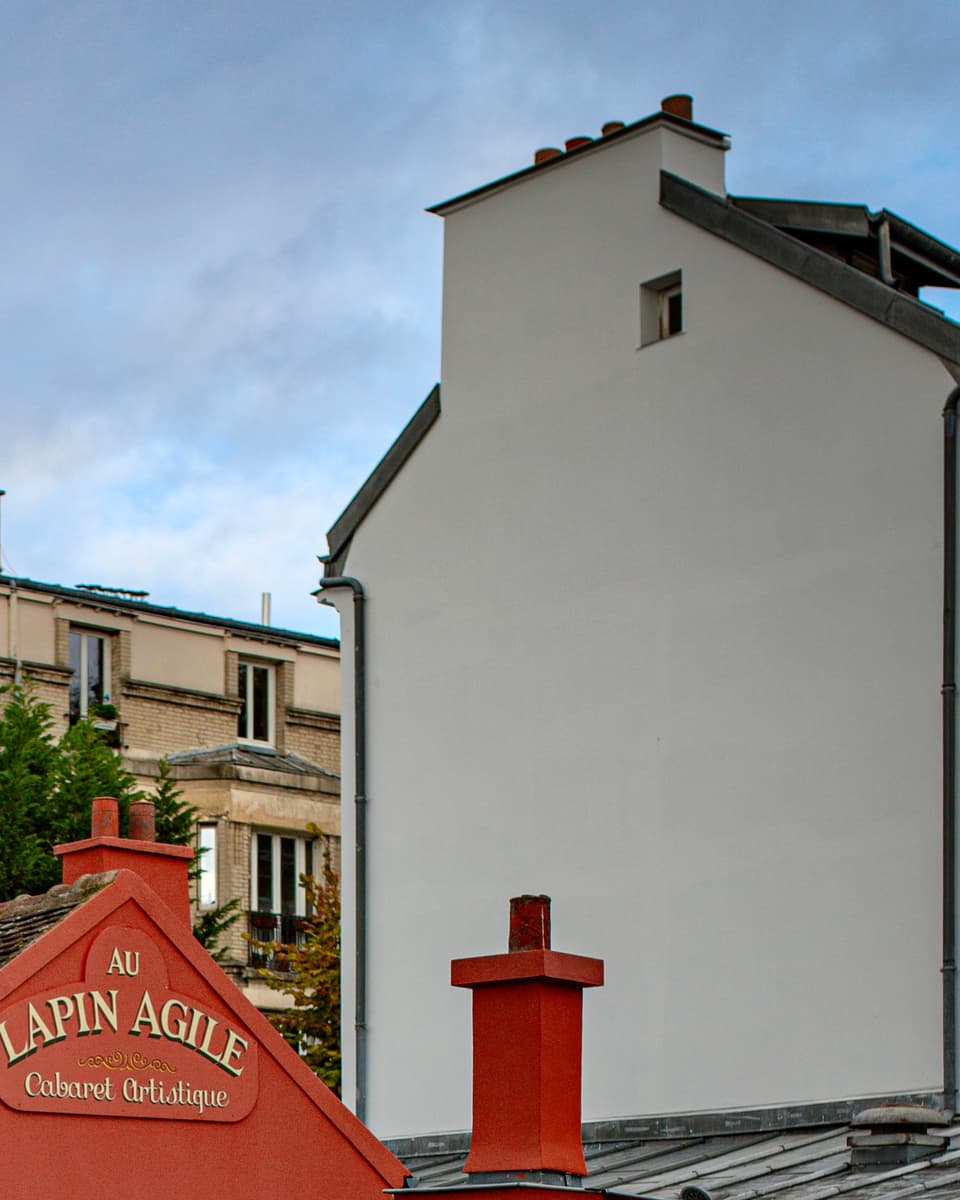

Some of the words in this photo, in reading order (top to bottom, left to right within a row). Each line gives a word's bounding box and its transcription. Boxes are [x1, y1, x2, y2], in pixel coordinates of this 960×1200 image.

[106, 947, 140, 976] AU
[128, 990, 248, 1078] AGILE
[25, 1072, 116, 1101] Cabaret
[122, 1077, 229, 1113] Artistique
